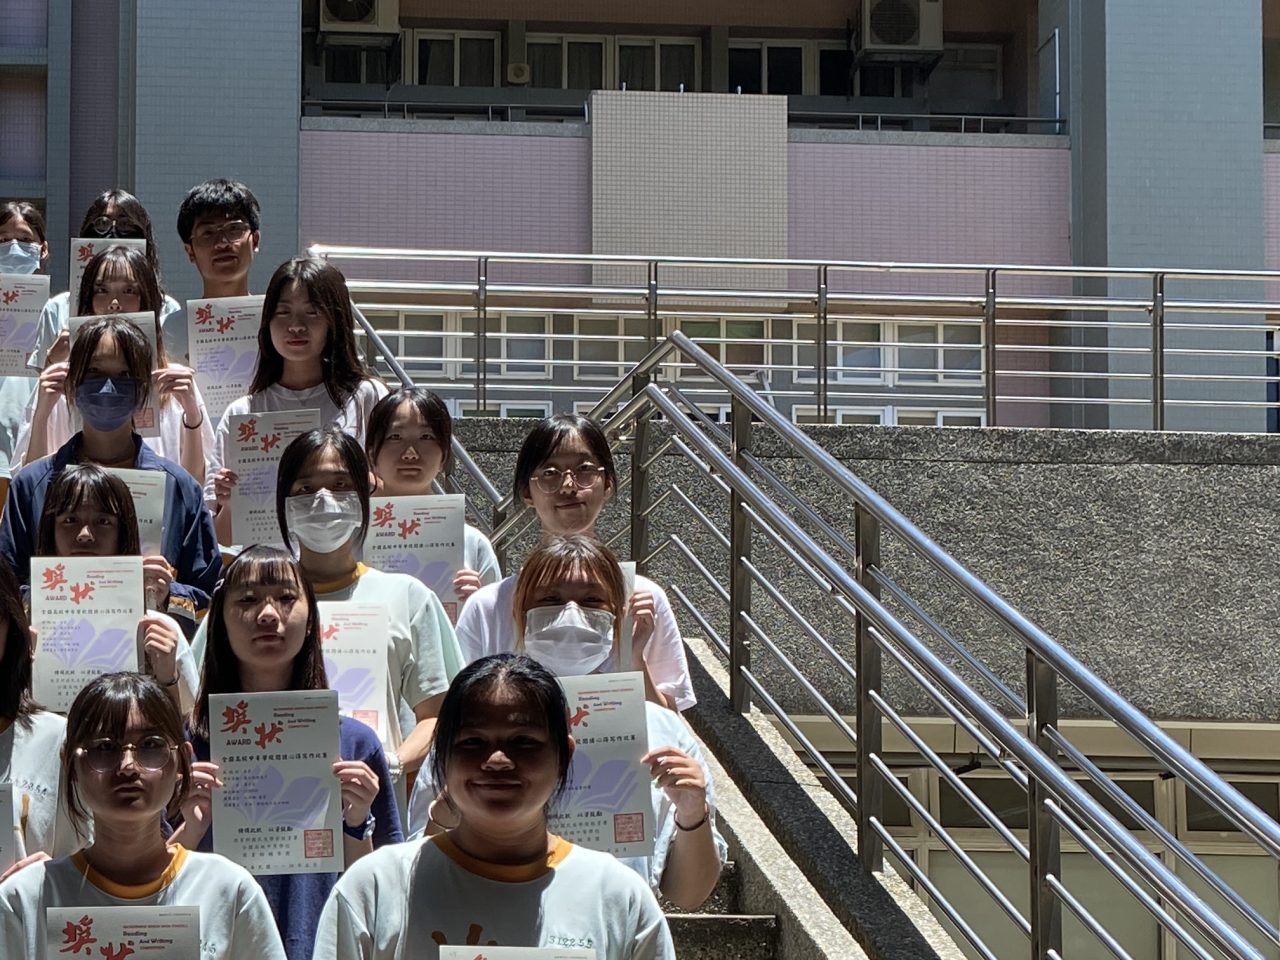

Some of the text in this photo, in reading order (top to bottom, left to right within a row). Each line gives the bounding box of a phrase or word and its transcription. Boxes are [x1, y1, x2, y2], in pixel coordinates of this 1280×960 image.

[236, 418, 281, 453] 獎狀
[371, 502, 421, 539] 獎狀
[41, 563, 95, 604] 獎狀
[220, 700, 283, 749] 獎狀
